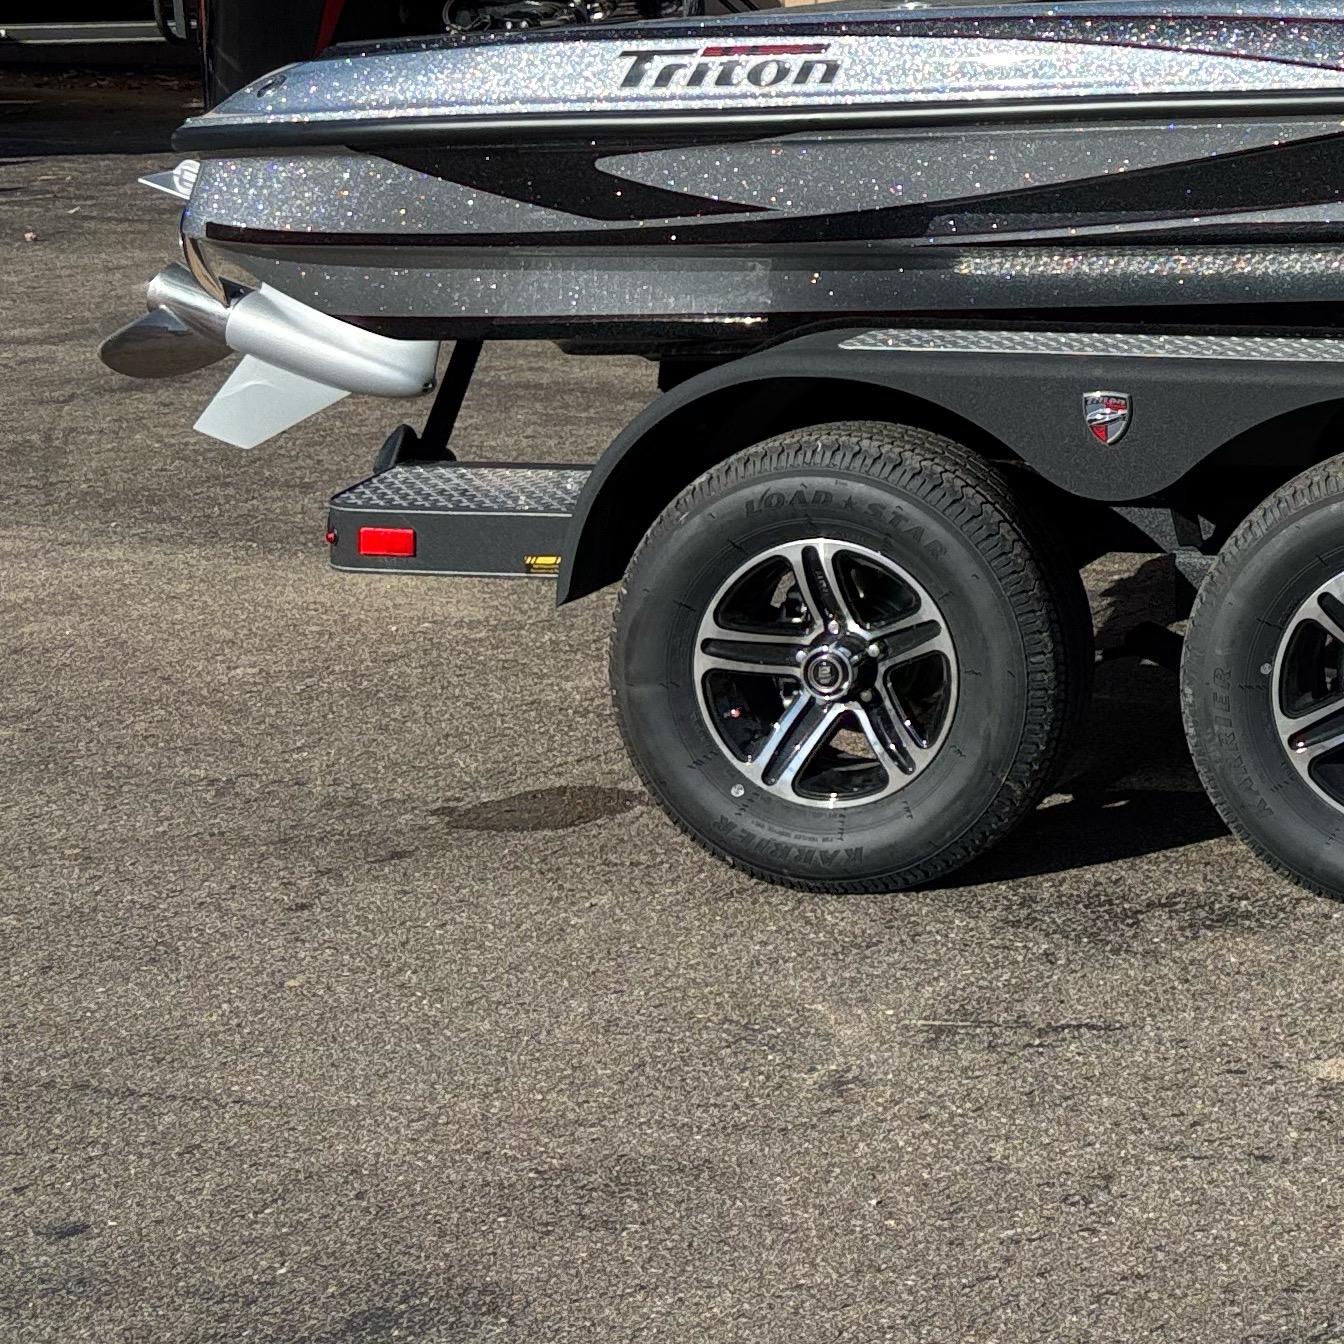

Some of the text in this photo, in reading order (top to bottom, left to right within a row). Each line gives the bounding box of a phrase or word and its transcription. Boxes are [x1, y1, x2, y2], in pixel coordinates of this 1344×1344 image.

[618, 47, 843, 88] Triton
[745, 486, 951, 561] LOAD STAR
